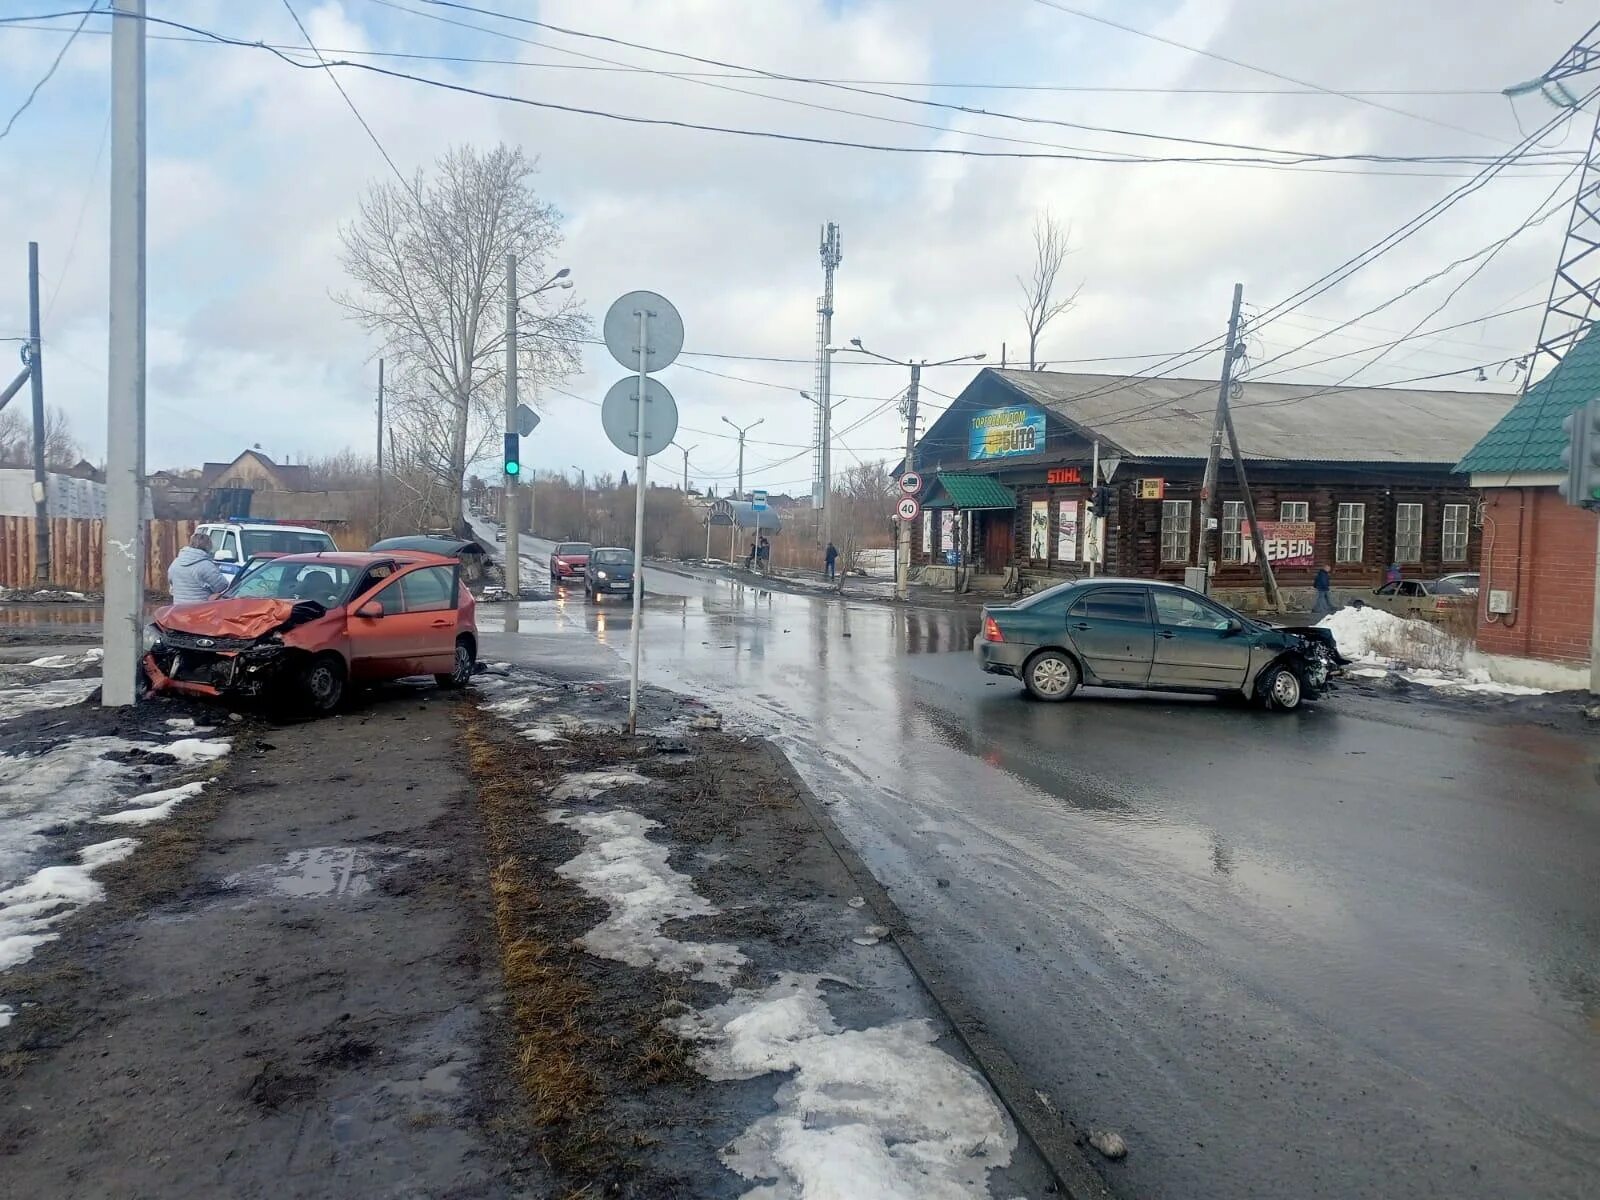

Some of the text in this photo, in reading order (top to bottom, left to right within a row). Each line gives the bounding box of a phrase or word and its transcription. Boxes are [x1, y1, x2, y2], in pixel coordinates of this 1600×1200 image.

[1047, 467, 1081, 484] STIHL
[901, 504, 914, 514] 40
[1242, 539, 1313, 564] МЕБЕЛЬ
